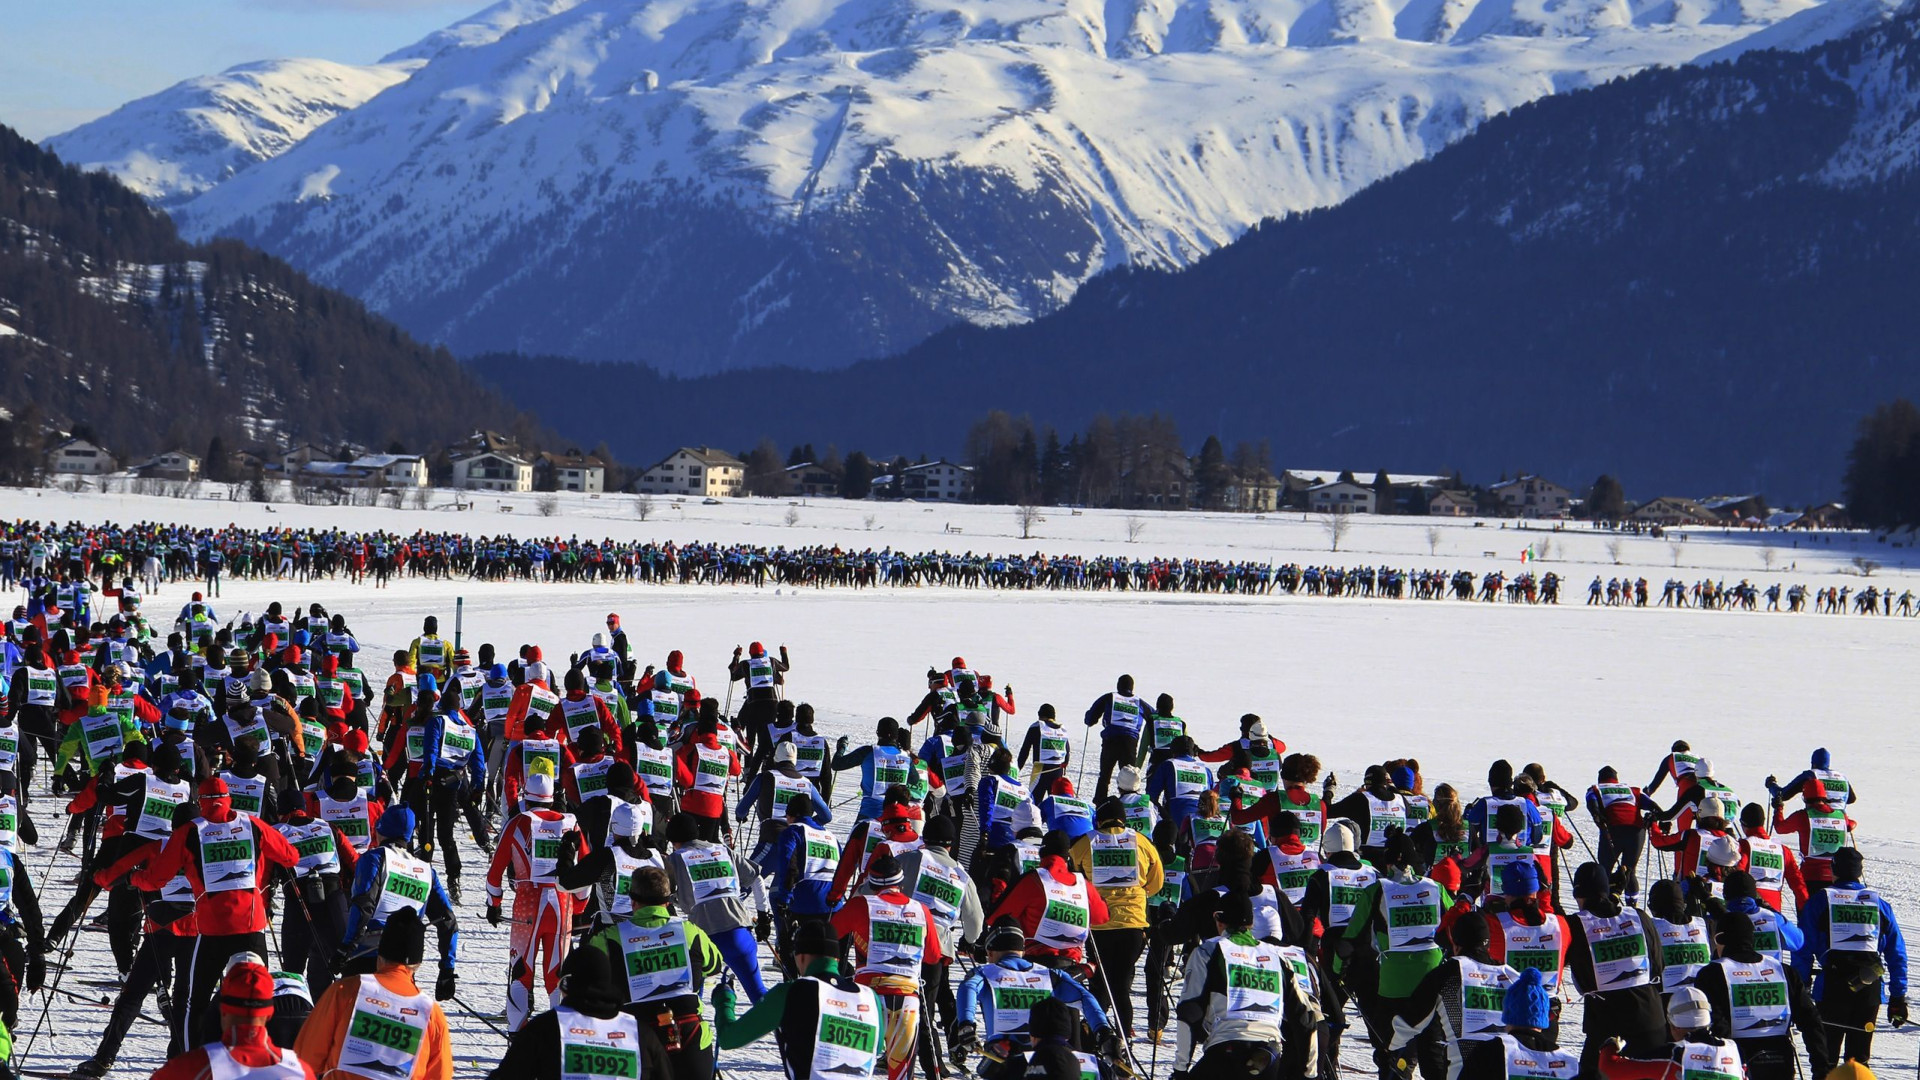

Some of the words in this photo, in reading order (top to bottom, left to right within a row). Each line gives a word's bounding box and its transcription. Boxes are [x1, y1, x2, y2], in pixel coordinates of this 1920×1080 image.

[1180, 774, 1203, 784] 31429
[150, 799, 174, 815] 3217
[1818, 833, 1839, 844] 3253
[210, 844, 247, 861] 31220
[1098, 853, 1130, 866] 30531
[1755, 855, 1779, 868] 31472
[694, 865, 728, 879] 30785
[1285, 875, 1310, 888] 3091
[390, 879, 423, 900] 31128
[1051, 905, 1083, 929] 31636
[1394, 911, 1432, 925] 30428
[1838, 911, 1873, 923] 30467
[628, 935, 650, 944] coop
[641, 941, 661, 949] helvetia
[1601, 941, 1640, 958] 31589
[634, 952, 679, 975] 30141
[1513, 957, 1553, 971] 31995
[1667, 950, 1705, 965] 30908
[1234, 971, 1274, 992] 30566
[365, 997, 390, 1009] coop
[826, 998, 848, 1009] coop
[1738, 990, 1780, 1006] 31695
[377, 1009, 399, 1020] helvetia
[358, 1016, 413, 1050] 32193
[569, 1027, 596, 1037] coop
[825, 1024, 868, 1051] 30571
[585, 1039, 610, 1047] helvetia
[1514, 1058, 1537, 1067] coop
[1690, 1054, 1711, 1062] coop
[572, 1053, 629, 1077] 31992
